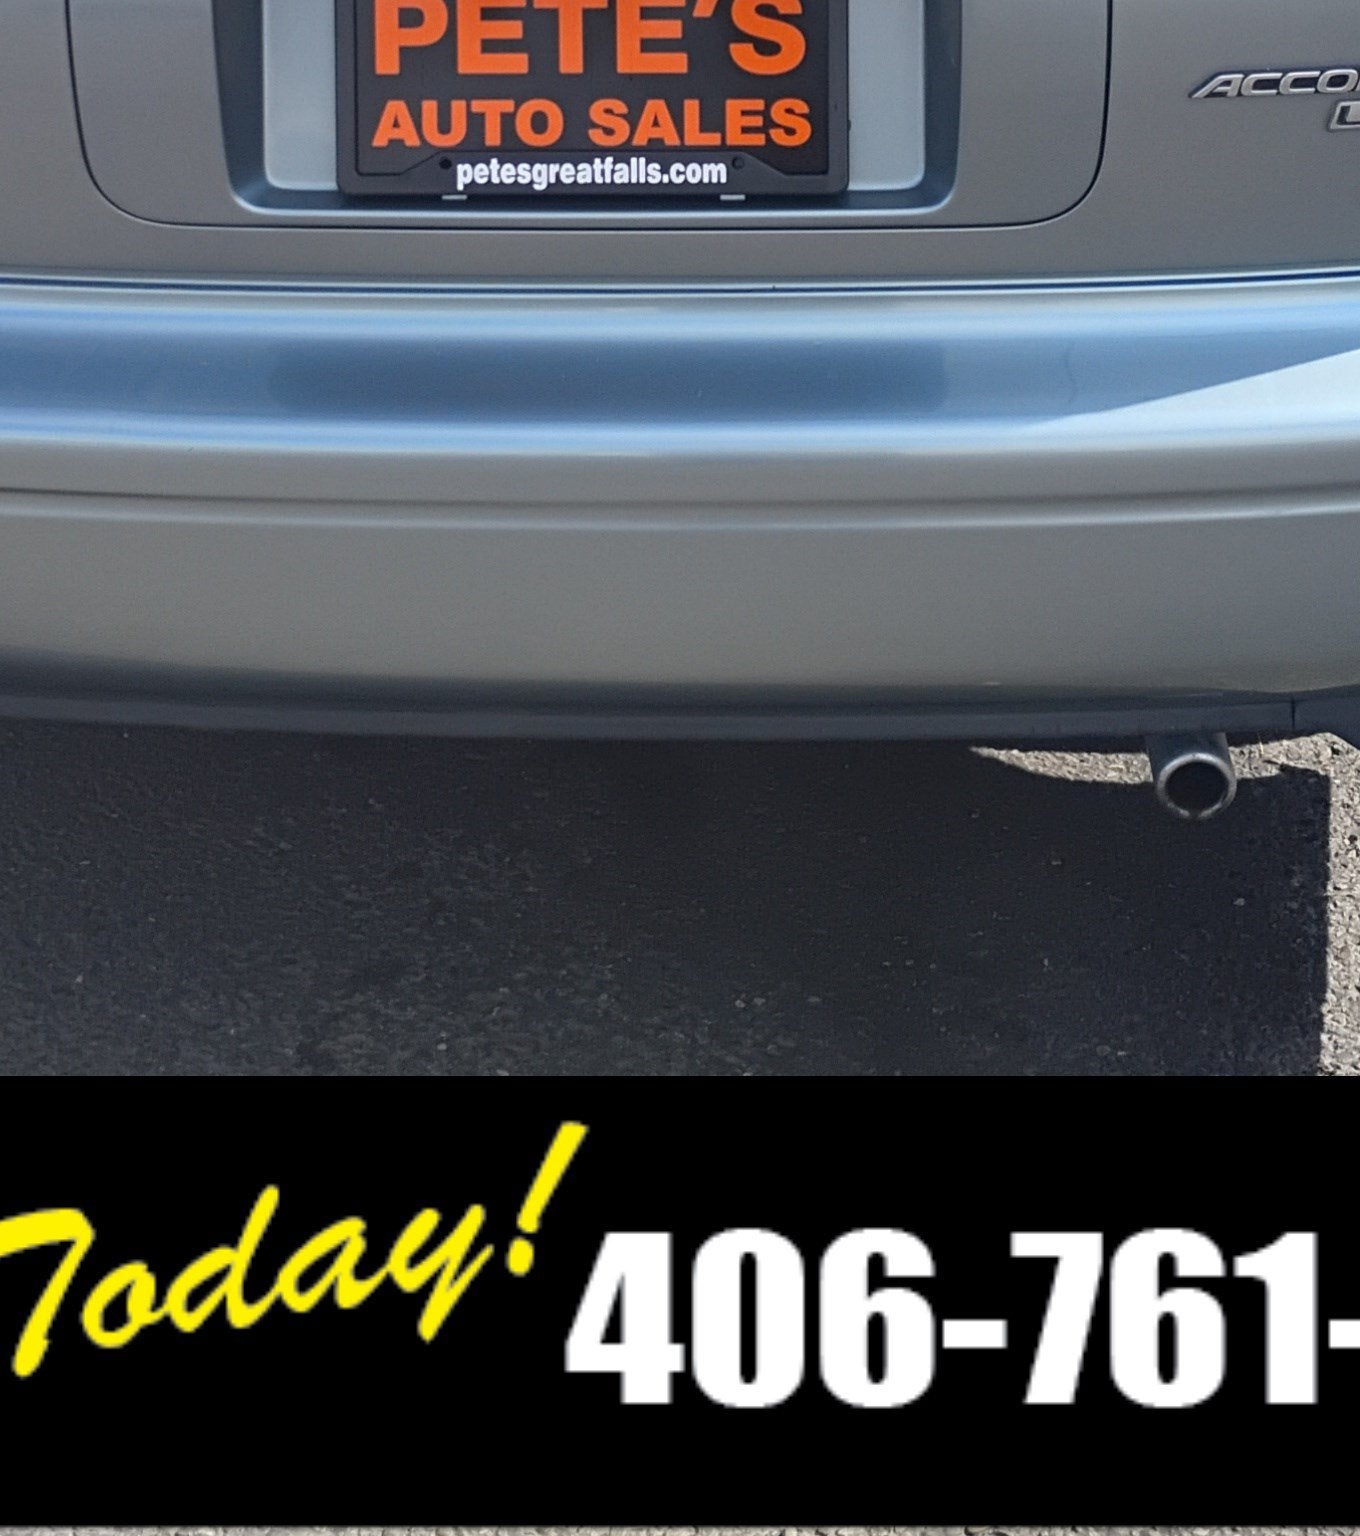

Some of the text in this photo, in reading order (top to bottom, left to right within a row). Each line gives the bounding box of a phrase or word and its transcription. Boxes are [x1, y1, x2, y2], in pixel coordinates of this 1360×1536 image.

[372, 97, 813, 148] AUTO SALES
[455, 157, 728, 191] petesgreatfalls.com
